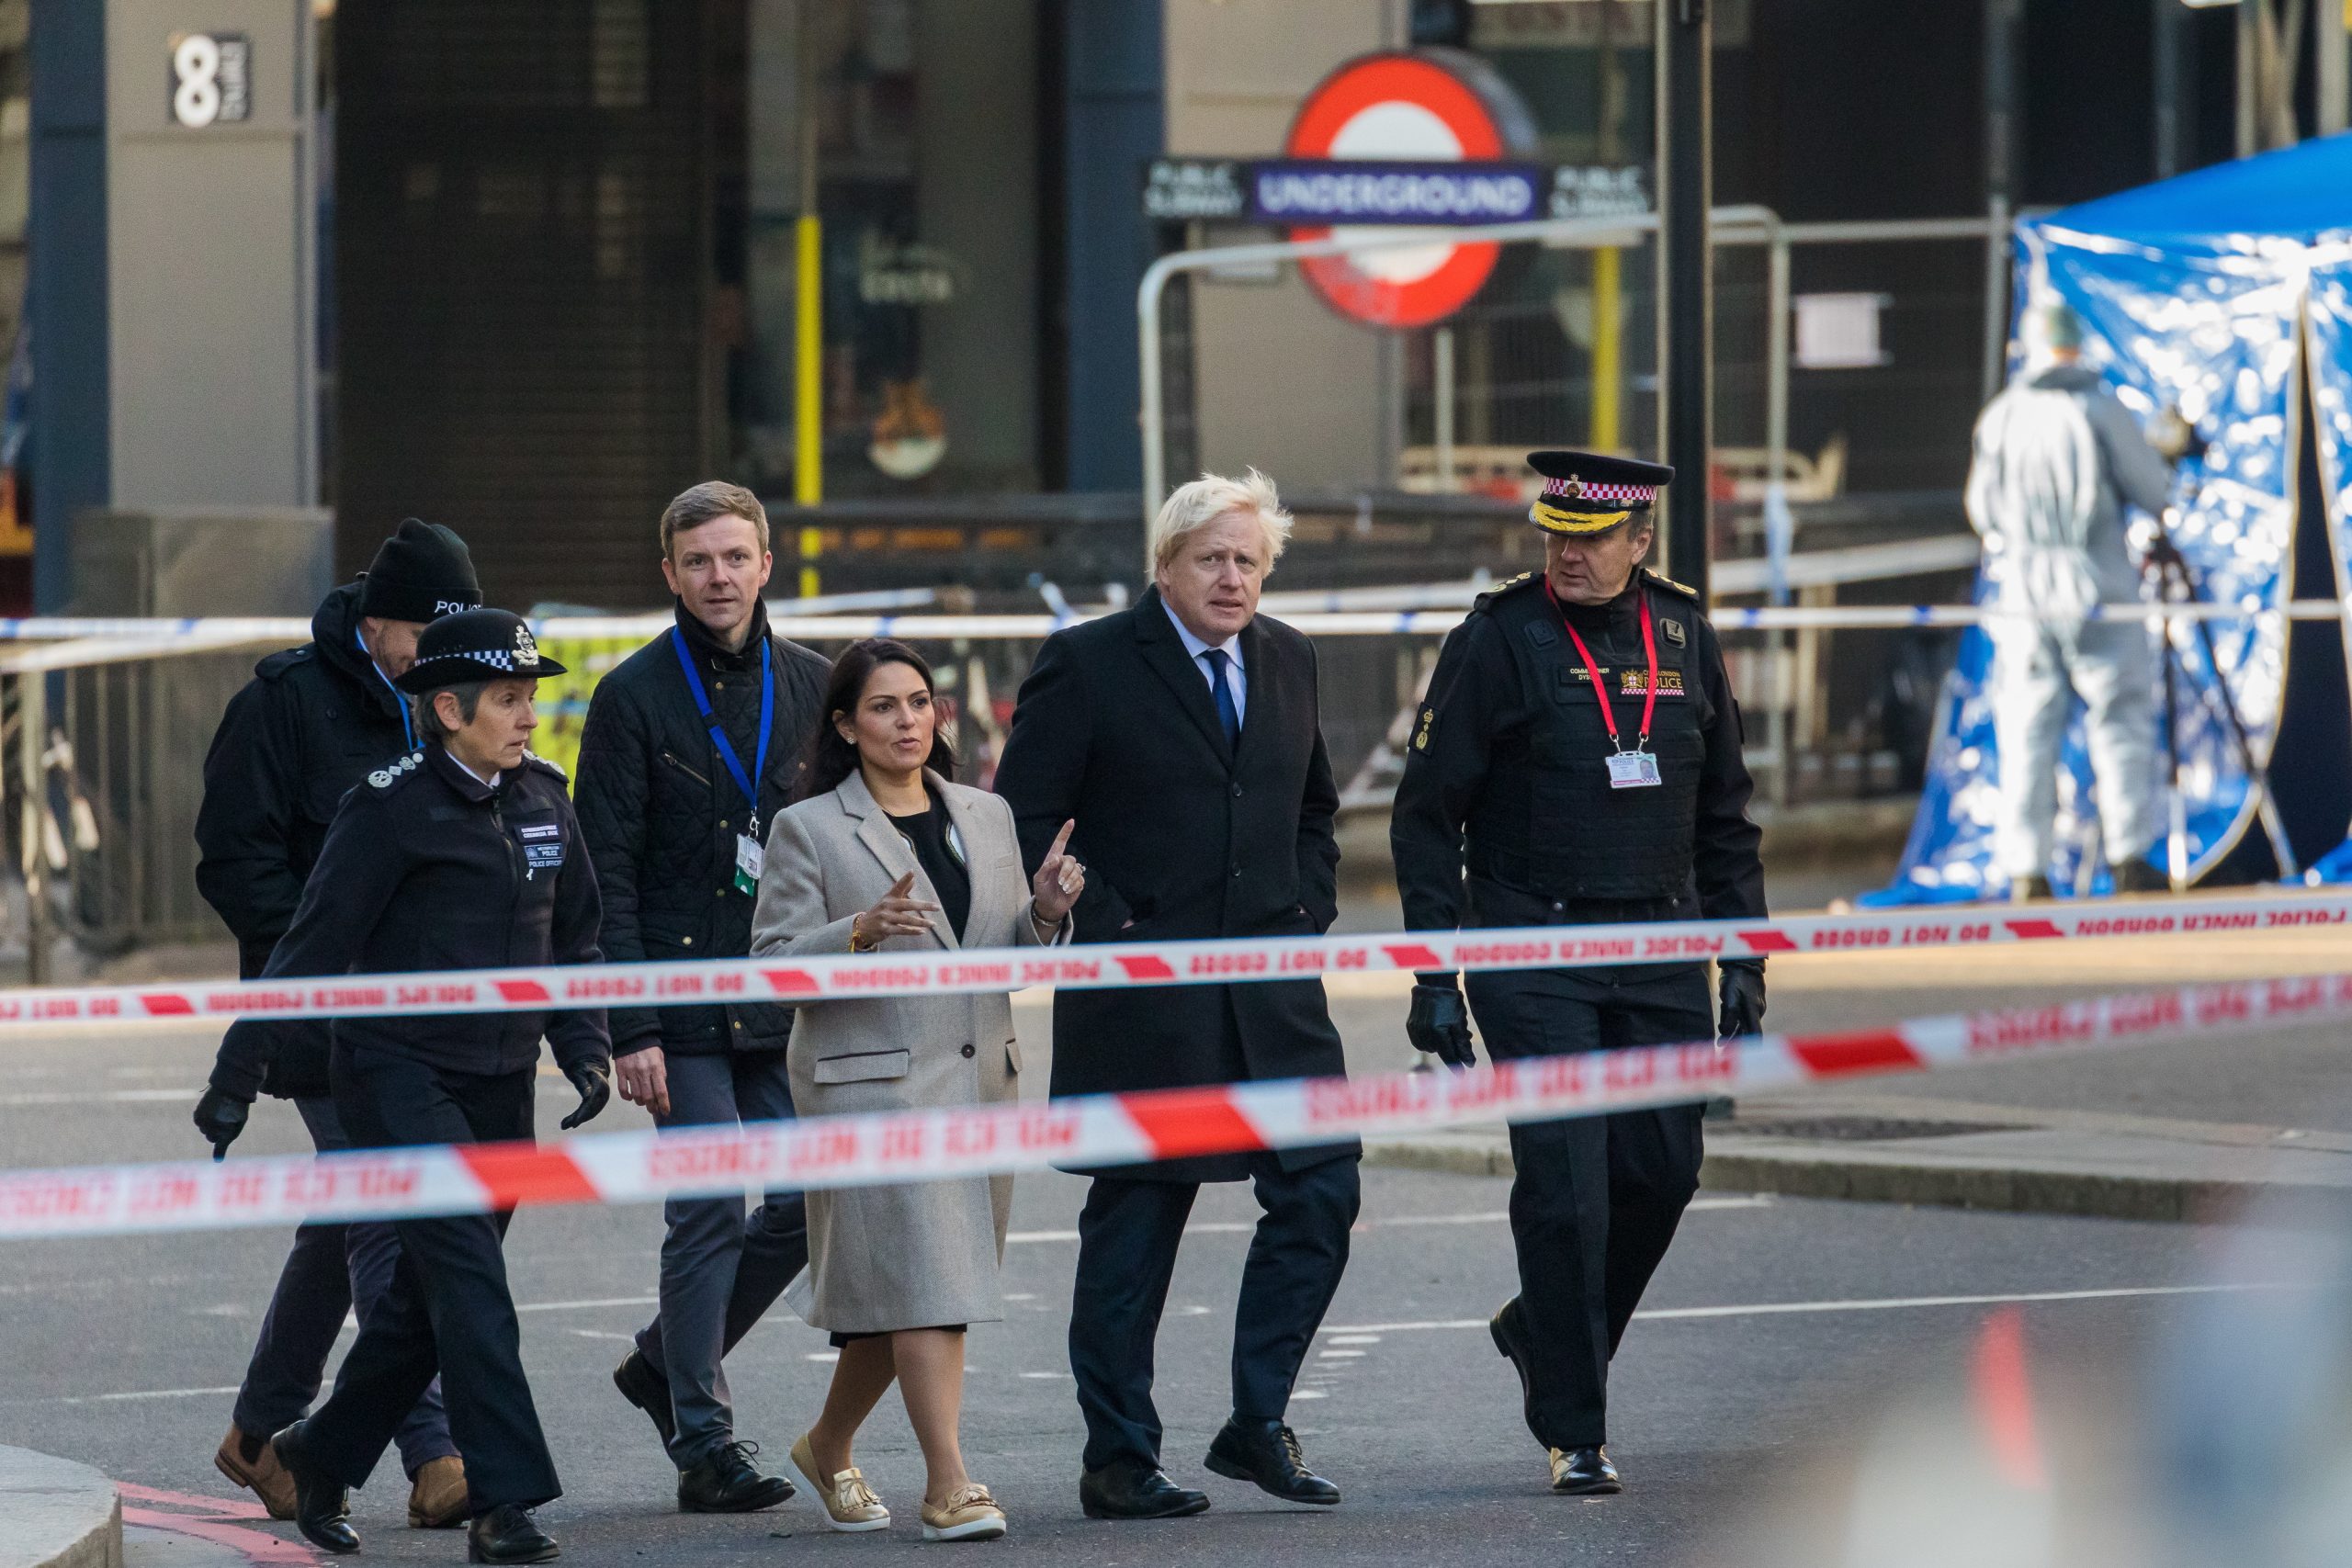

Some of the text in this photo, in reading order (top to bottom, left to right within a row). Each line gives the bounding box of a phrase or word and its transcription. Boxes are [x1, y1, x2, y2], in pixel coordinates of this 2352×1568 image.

[1257, 174, 1532, 215] UNDERGROUND
[528, 860, 546, 868] POLICE
[2183, 912, 2257, 931] INNER
[2266, 908, 2346, 928] POLICE
[1901, 926, 1951, 946] NOT
[1958, 922, 1992, 941] DO
[1558, 938, 1635, 961] INNER
[1643, 935, 1724, 956] POLICE
[1278, 949, 1327, 972] NOT
[1335, 947, 1369, 969] DO
[1021, 959, 1102, 983] POLICE
[654, 975, 703, 997] NOT
[711, 973, 745, 994] DO
[86, 998, 120, 1018] DO
[944, 1104, 1082, 1155] POLICE
[281, 1161, 423, 1207] POLICE
